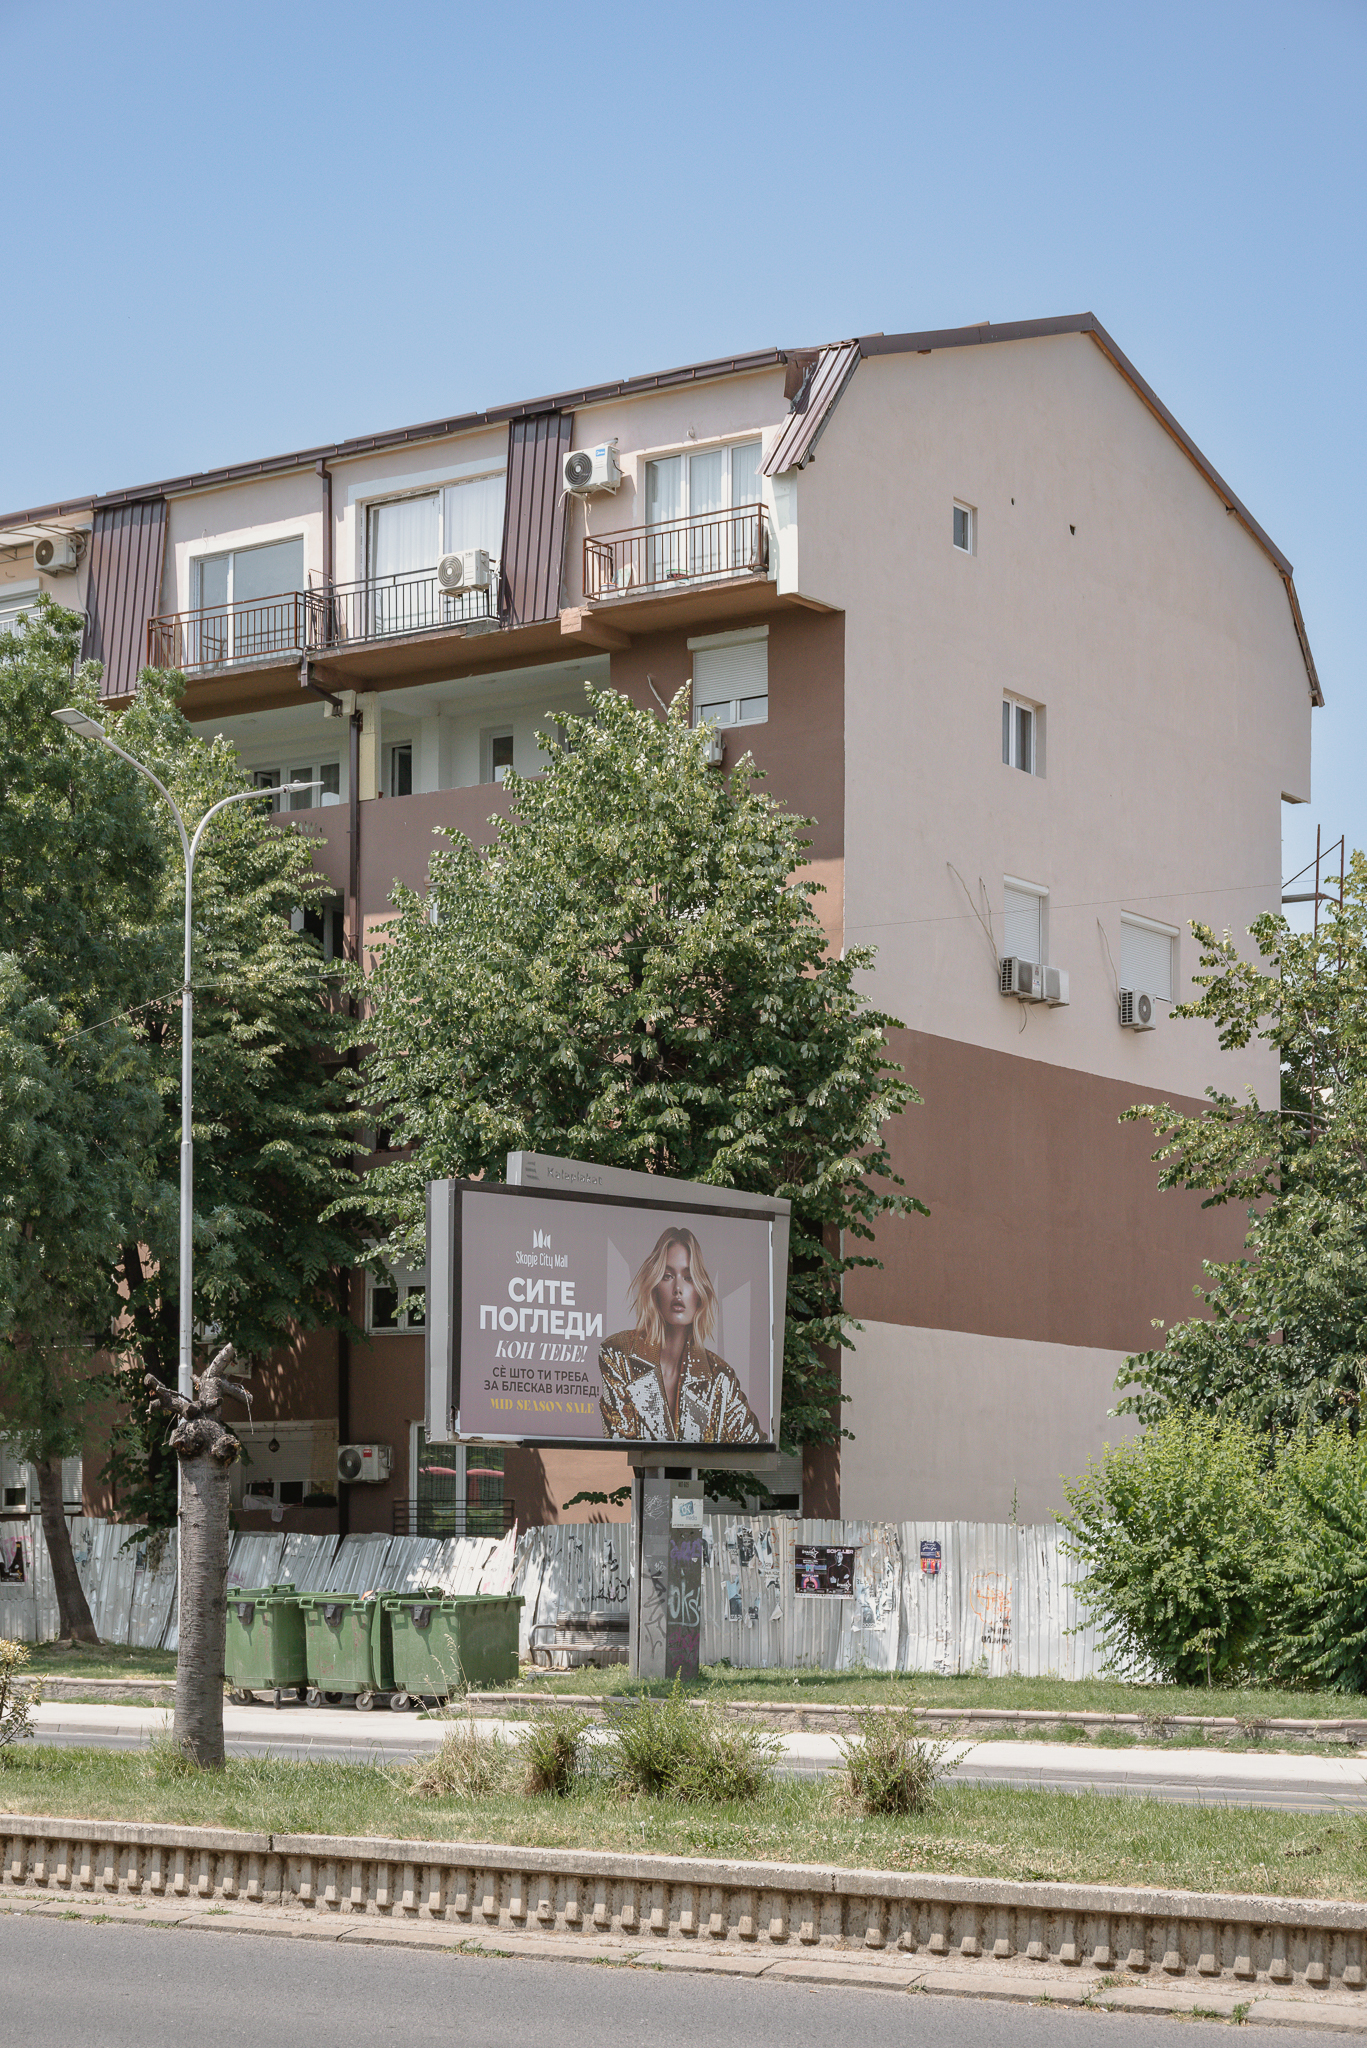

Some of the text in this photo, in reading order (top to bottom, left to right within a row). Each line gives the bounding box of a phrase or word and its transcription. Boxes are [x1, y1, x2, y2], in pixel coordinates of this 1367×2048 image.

[515, 1250, 568, 1270] Skopje City Mall
[507, 1276, 576, 1306] СИТЕ
[479, 1304, 603, 1341] ПОГЛЕДИ
[494, 1340, 589, 1363] КОН ТЕБЕ!
[509, 1367, 535, 1380] ШТО
[538, 1369, 552, 1381] ТИ
[554, 1370, 589, 1383] ТРЕБА
[483, 1379, 600, 1398] ЗА БЛЕСКАВ ИЗГЛЕД!
[489, 1398, 595, 1415] MID SEASON SALE
